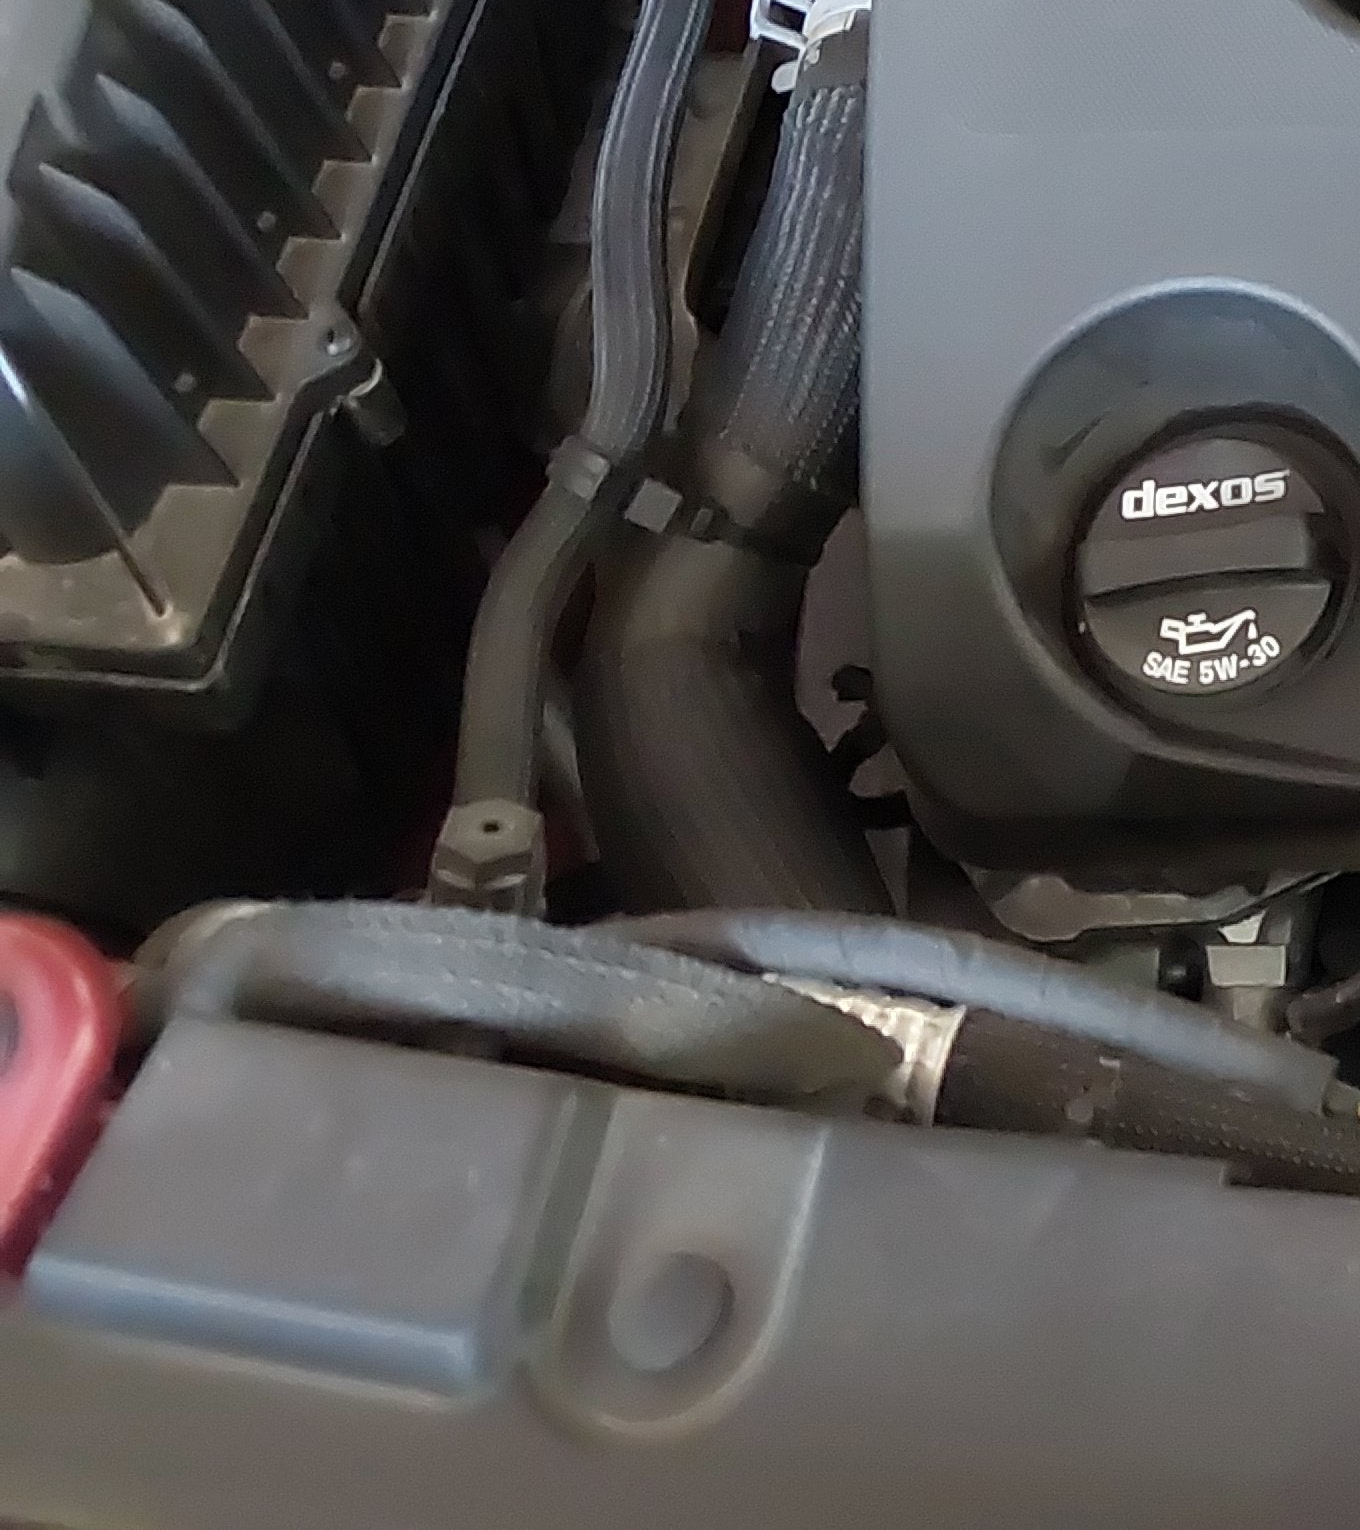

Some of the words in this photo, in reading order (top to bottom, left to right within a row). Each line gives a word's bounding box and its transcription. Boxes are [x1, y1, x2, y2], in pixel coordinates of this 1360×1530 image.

[1121, 468, 1290, 520] dexos
[1142, 652, 1191, 684] SAE
[1199, 635, 1280, 685] 5W-30
